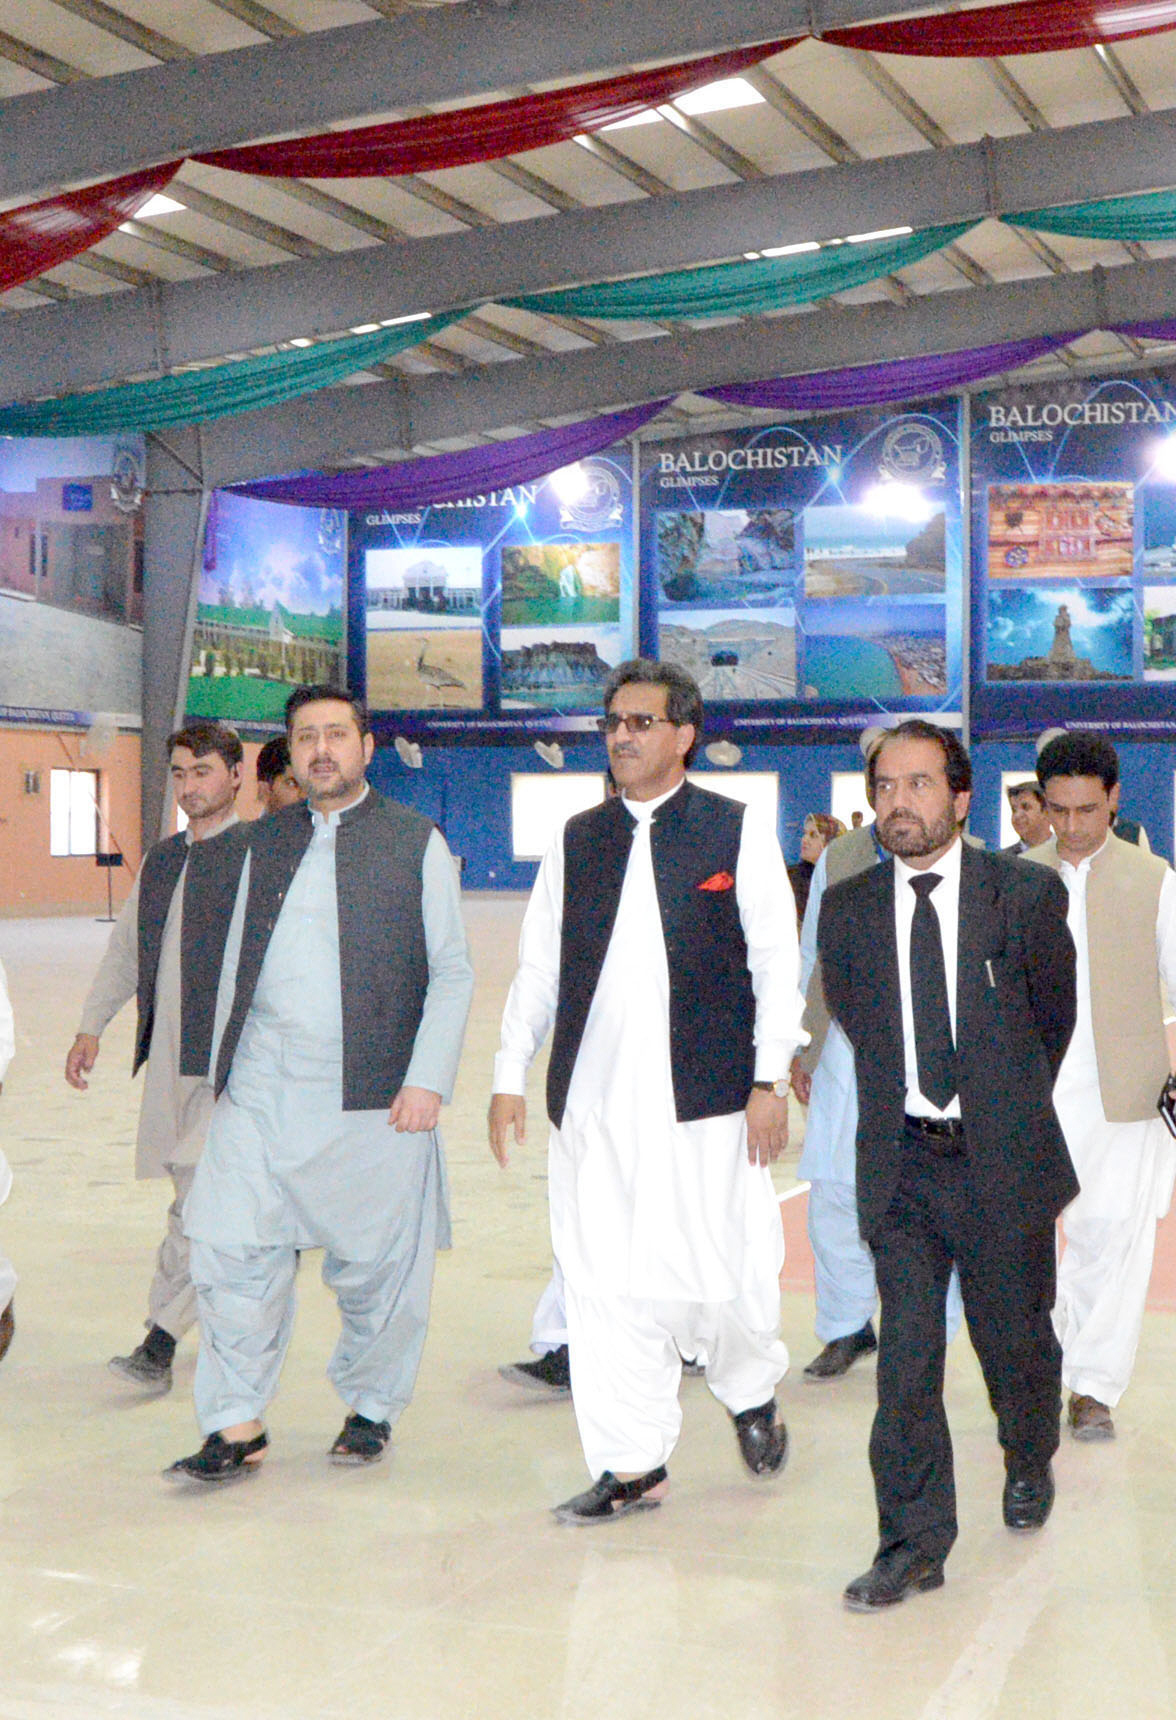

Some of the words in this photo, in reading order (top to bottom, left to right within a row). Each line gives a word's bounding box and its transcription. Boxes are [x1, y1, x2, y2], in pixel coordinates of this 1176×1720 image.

[990, 430, 1053, 444] GLIMPSES
[659, 445, 843, 473] BALOCHISTAN
[660, 475, 720, 489] GLIMPSES
[366, 513, 422, 526] GLIMPSES
